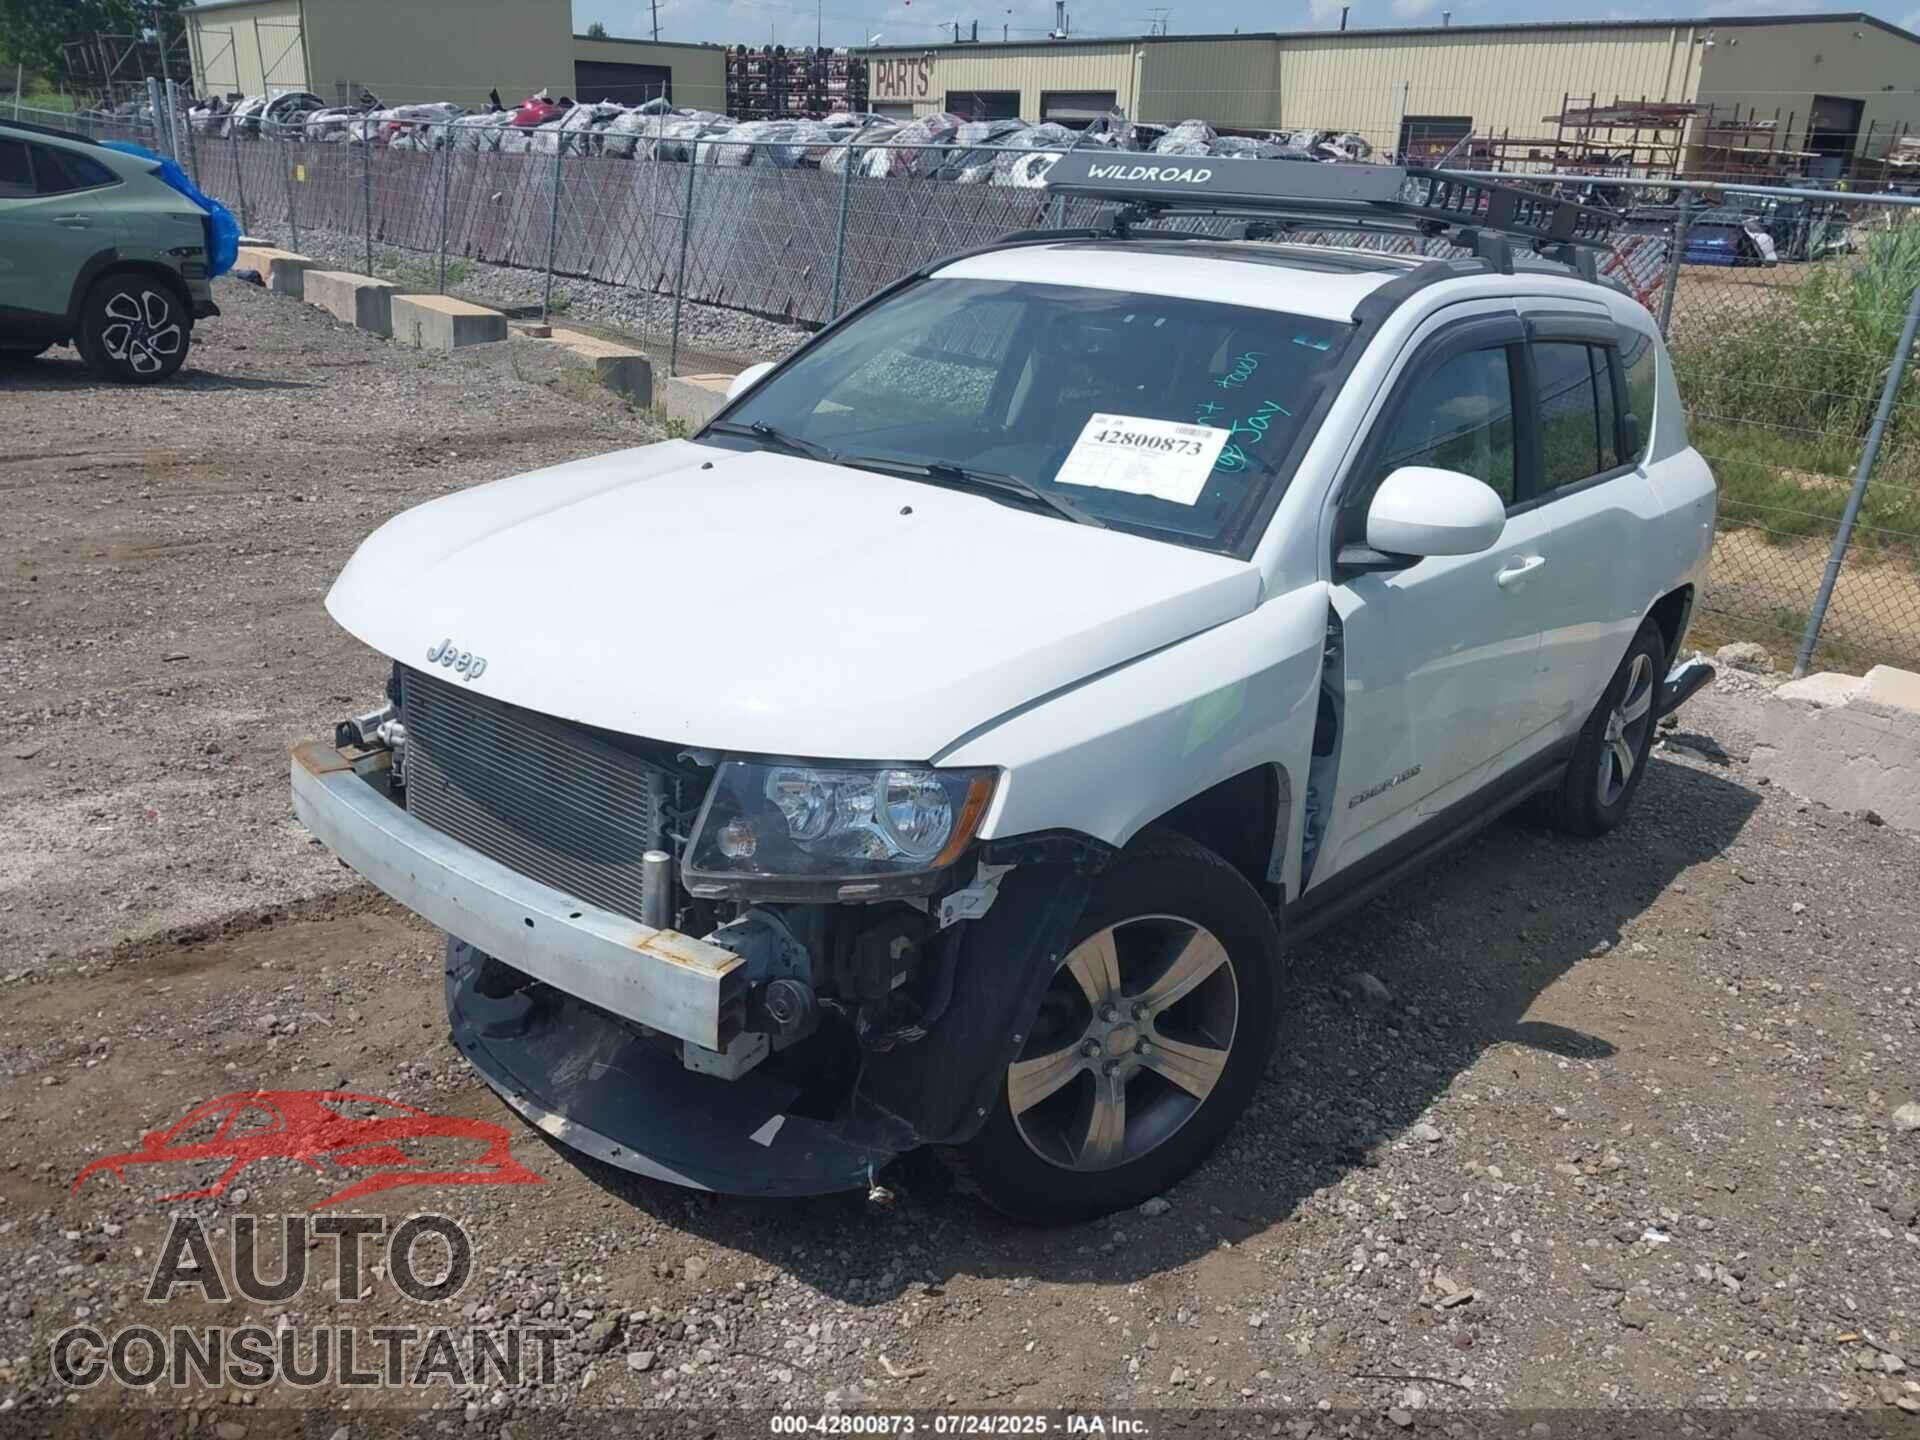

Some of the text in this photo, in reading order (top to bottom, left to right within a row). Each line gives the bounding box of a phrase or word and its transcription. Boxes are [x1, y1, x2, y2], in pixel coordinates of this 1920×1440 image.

[876, 57, 928, 97] PARTS
[1088, 164, 1212, 183] WILDROAD
[1094, 429, 1204, 456] 42800873
[427, 638, 488, 682] Jeep
